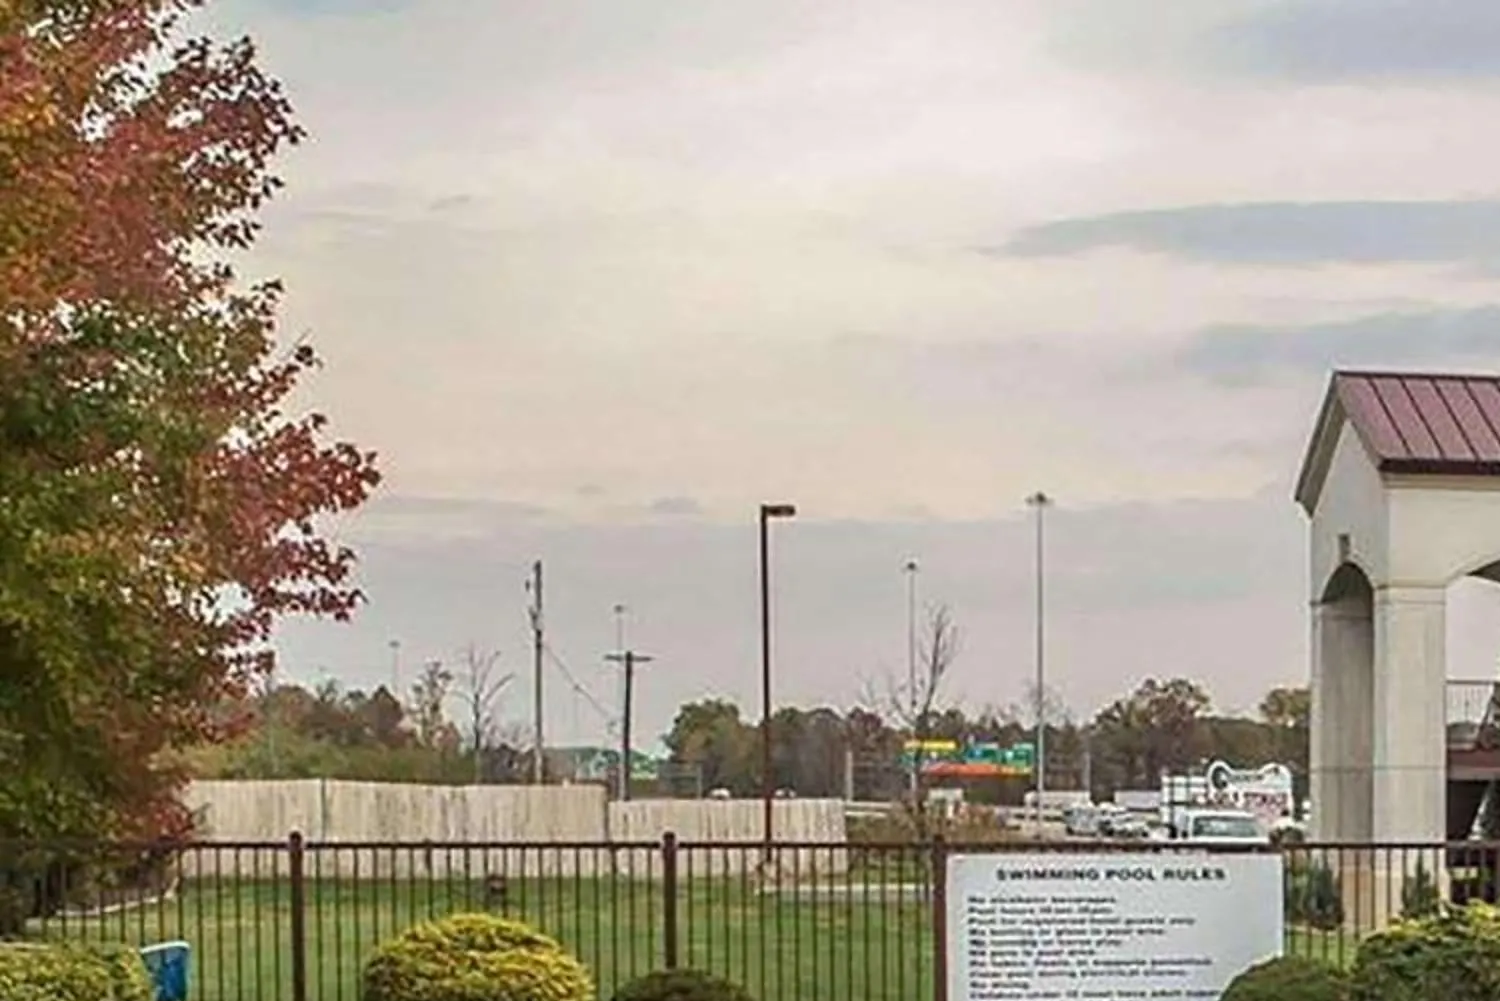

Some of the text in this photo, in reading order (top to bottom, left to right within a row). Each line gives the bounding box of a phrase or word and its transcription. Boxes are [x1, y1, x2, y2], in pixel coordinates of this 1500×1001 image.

[996, 868, 1225, 880] SWIMMING POOL RULES
